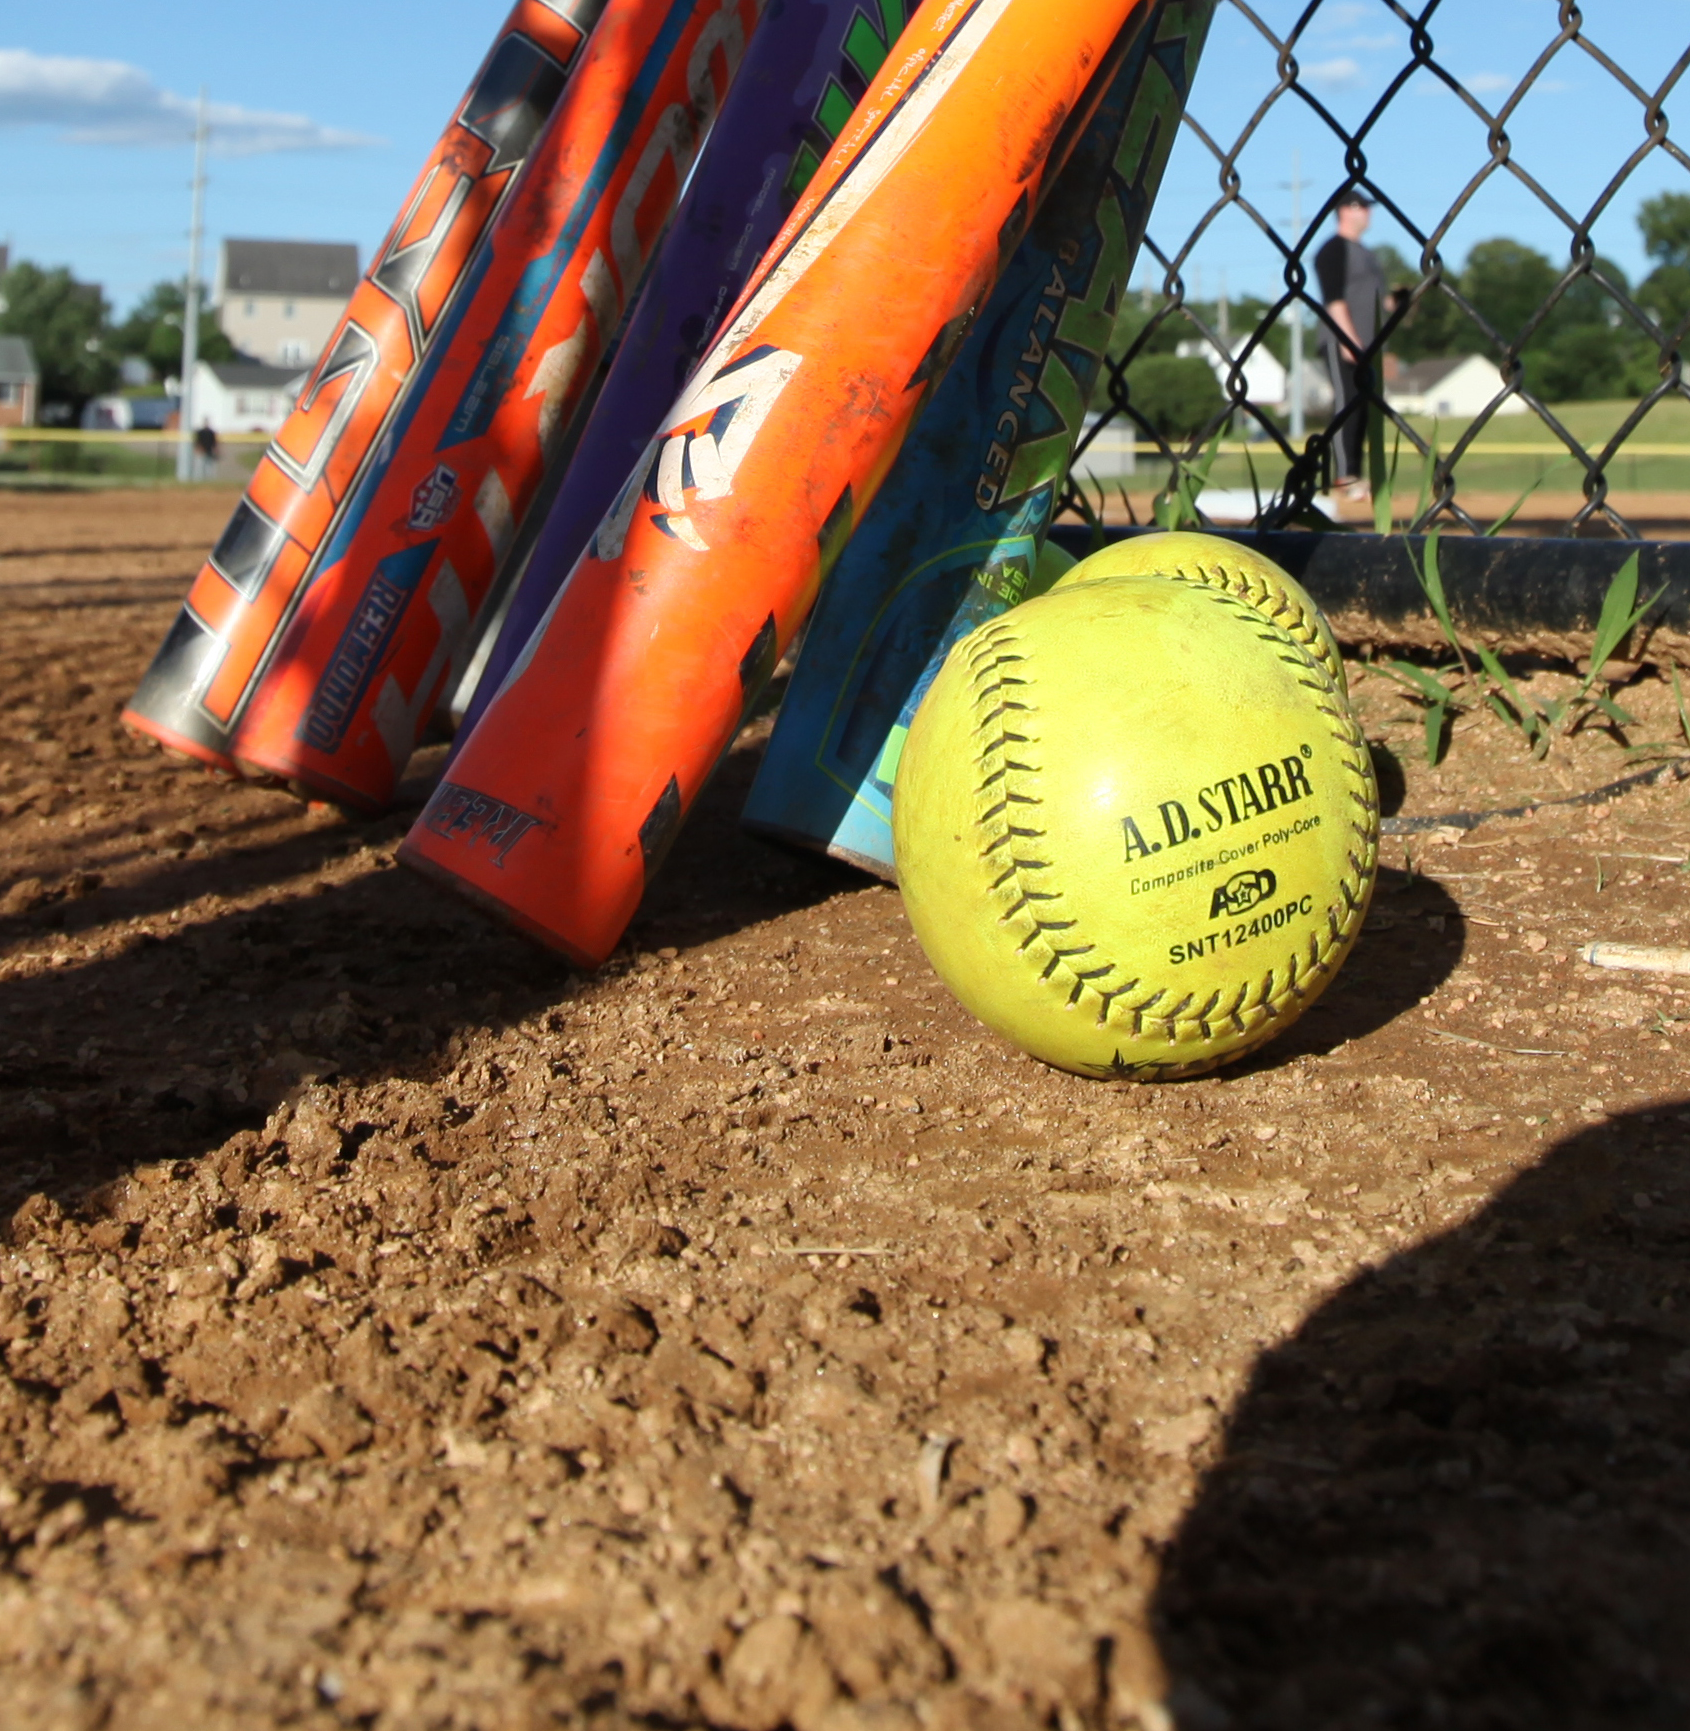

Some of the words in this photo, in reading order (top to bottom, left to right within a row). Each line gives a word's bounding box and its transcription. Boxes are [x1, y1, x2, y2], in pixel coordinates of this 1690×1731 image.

[974, 236, 1081, 511] BALANCED
[301, 575, 407, 749] RESMONDO
[1130, 856, 1215, 896] Composite
[1218, 838, 1261, 864] Cover
[1262, 814, 1321, 849] Poly-Core
[1169, 894, 1314, 965] SNT12400PC
